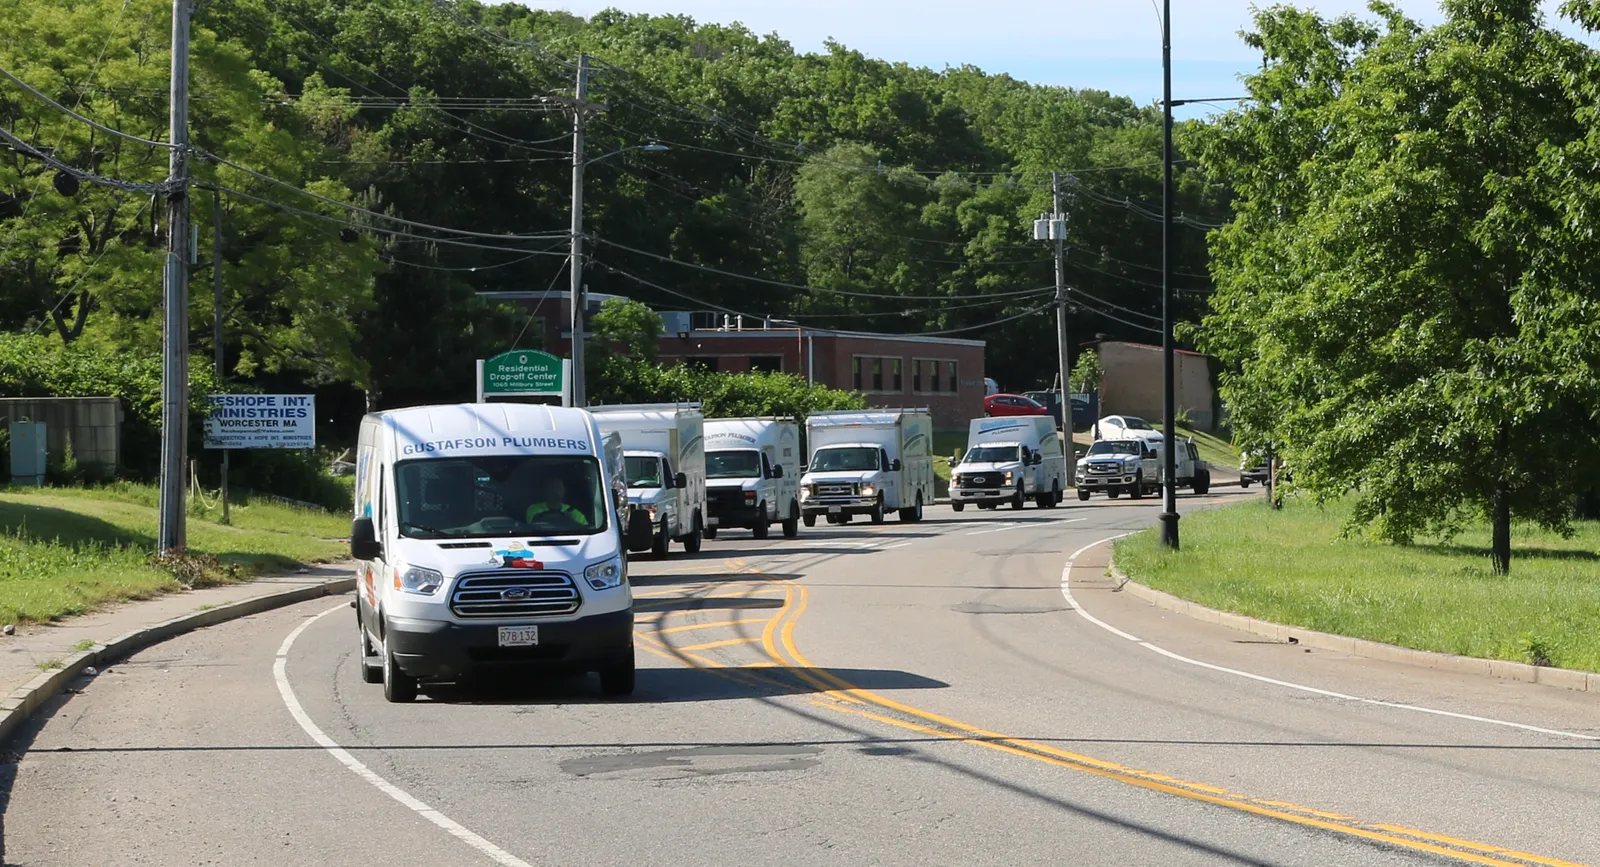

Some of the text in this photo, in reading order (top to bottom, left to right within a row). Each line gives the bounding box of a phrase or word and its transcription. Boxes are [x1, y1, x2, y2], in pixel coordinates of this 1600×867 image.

[489, 373, 525, 381] Drop-off
[283, 396, 311, 406] INT.
[210, 408, 307, 418] MINISTRIES
[403, 437, 587, 455] GUSTAFSON PLUMBERS
